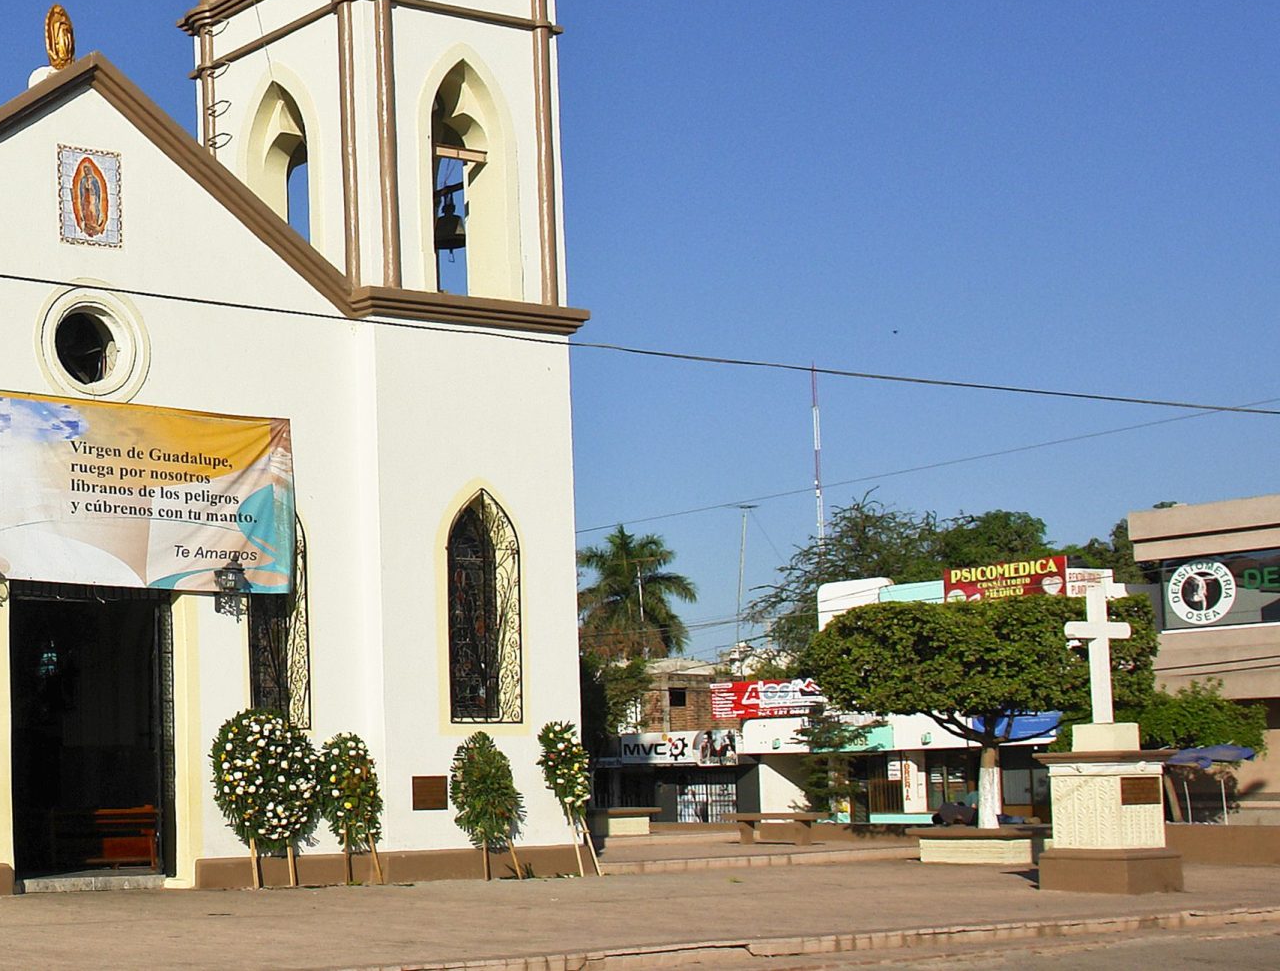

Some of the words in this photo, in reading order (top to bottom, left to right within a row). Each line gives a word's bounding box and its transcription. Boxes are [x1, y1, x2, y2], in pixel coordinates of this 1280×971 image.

[70, 440, 122, 459] Virgen
[127, 446, 144, 460] de
[149, 448, 233, 470] Guadalupe,
[71, 462, 114, 478] ruega
[120, 468, 146, 480] por
[150, 471, 211, 485] nosotros
[71, 478, 133, 496] líbranos
[138, 485, 156, 498] de
[160, 487, 180, 500] los
[185, 490, 240, 507] peligros
[71, 501, 80, 514] y
[85, 499, 153, 517] cúbrenos
[158, 508, 183, 519] con
[188, 508, 201, 521] tu
[206, 512, 258, 524] manto.
[174, 544, 190, 558] Te
[194, 546, 257, 561] Amamos
[951, 558, 1058, 584] PSICOMEDICA
[1171, 562, 1233, 604] DENSITOMETRIA
[1186, 609, 1221, 622] OSEA
[623, 743, 667, 756] MVC
